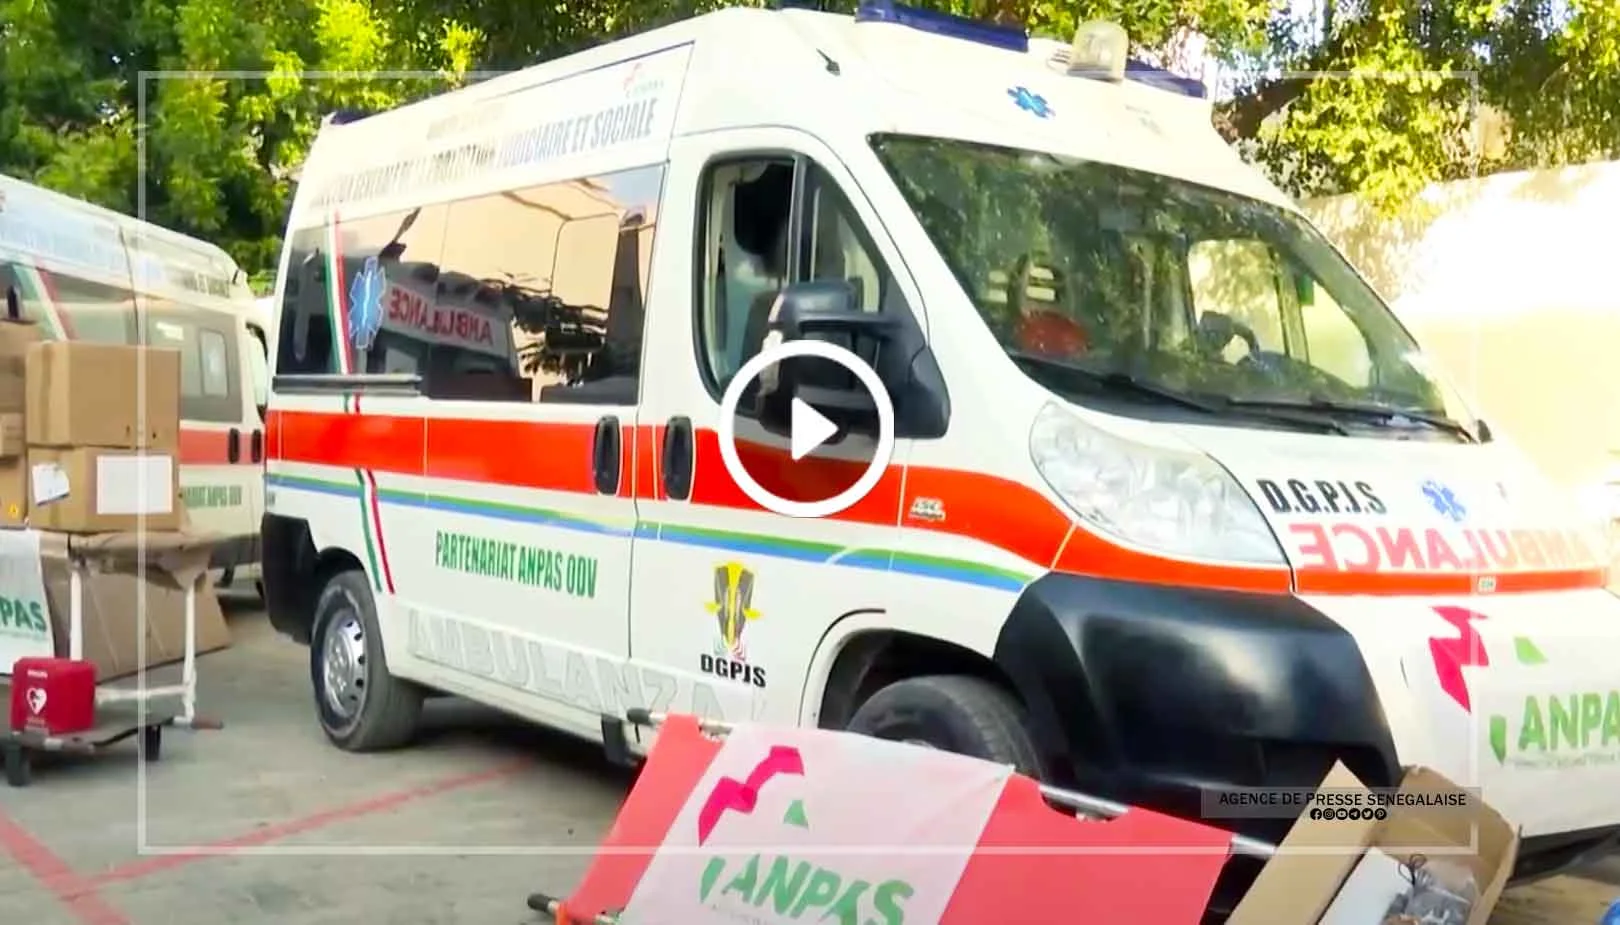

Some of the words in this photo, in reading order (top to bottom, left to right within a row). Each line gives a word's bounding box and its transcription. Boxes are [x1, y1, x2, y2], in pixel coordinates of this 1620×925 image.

[572, 114, 594, 153] ET
[590, 97, 658, 149] SOCIALE
[435, 530, 516, 581] PARTENARIAT
[518, 545, 562, 591] ANPAS
[566, 553, 598, 599] ODV
